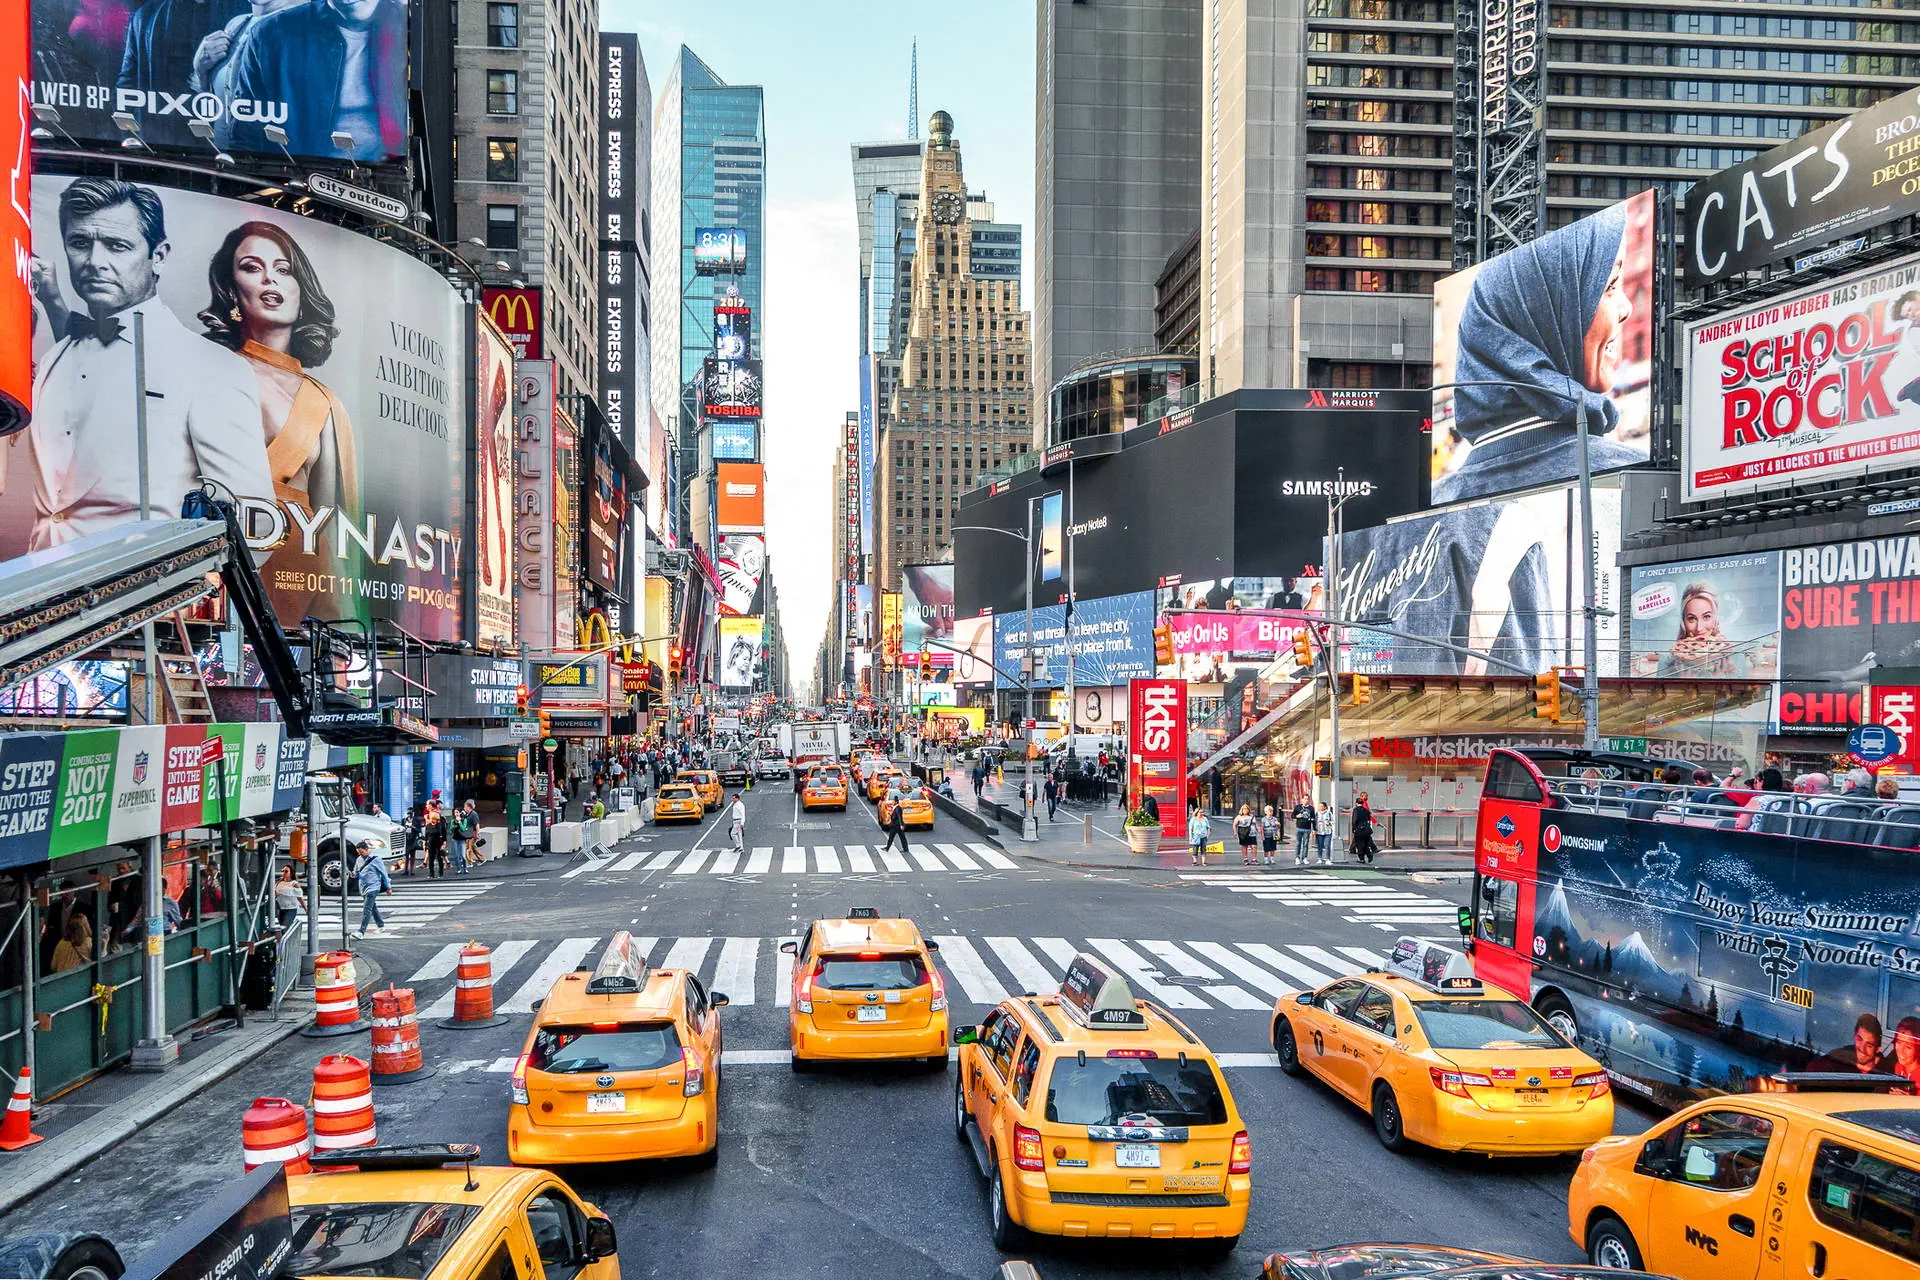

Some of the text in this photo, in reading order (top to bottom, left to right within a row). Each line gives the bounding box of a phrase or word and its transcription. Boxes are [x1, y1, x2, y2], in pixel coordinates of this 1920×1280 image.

[608, 46, 622, 119] EXPRESS
[40, 81, 81, 107] WED
[86, 85, 110, 111] 8P
[608, 131, 621, 198] EXPRESS
[318, 180, 401, 213] city outdoor
[1696, 120, 1853, 271] CATS
[1792, 207, 1870, 239] CATSBROADWAY.COM
[702, 232, 738, 248] 8:30
[720, 298, 744, 307] 2017
[1744, 308, 1780, 332] LLOYD
[1782, 293, 1830, 320] WEBBER
[1832, 285, 1857, 307] HAS
[390, 320, 446, 371] VICIOUS.
[607, 297, 621, 373] EXPRESS
[1721, 300, 1904, 387] SCHOOL
[1786, 356, 1823, 397] of
[1332, 391, 1380, 399] MARRIOTT
[1332, 399, 1375, 407] MARQUIS
[1720, 351, 1901, 450] ROCK
[705, 405, 761, 416] TOSHIBA
[1171, 407, 1196, 421] MARRIOTT
[863, 404, 871, 446] NINJAS
[1170, 416, 1193, 430] MARQUIS
[1789, 432, 1821, 447] MUSICAL
[864, 451, 872, 478] PLAY
[1743, 462, 1765, 477] JUST
[1767, 461, 1774, 475] 4
[1775, 454, 1811, 471] BLOCKS
[1813, 452, 1826, 464] TO
[1828, 448, 1846, 461] THE
[1848, 440, 1888, 457] WINTER
[520, 376, 541, 591] PALACE
[1282, 480, 1371, 496] SAMSUNG
[1087, 516, 1107, 530] Note8
[236, 495, 462, 581] DYNASTY
[275, 570, 305, 583] SERIES
[1336, 521, 1451, 623] Honestly
[1639, 556, 1768, 578] IF ONLY LIFE WERE AS EASY AS PIE
[275, 582, 305, 593] PREMIERE
[307, 572, 337, 594] OCT
[339, 576, 354, 596] 11
[358, 578, 388, 600] WED
[391, 582, 405, 601] 9P
[907, 605, 938, 618] KNOW
[1784, 584, 1860, 630] SURE
[1005, 618, 1129, 643] Next you leave the city,
[1194, 622, 1229, 642] On Us
[1083, 641, 1104, 655] places
[1105, 638, 1124, 650] from
[1125, 636, 1133, 649] it.
[1356, 653, 1373, 661] THE
[471, 669, 489, 685] STAY
[489, 671, 496, 685] IN
[476, 688, 492, 704] NEW
[309, 712, 381, 723] NORTH SHORE
[555, 720, 592, 728] NOVEMBER
[1144, 685, 1178, 752] tkts
[280, 740, 306, 760] STEP
[801, 741, 831, 749] MIVILA
[1370, 736, 1414, 759] tkts
[1413, 737, 1456, 759] tkts
[1611, 739, 1635, 751] W 47
[69, 753, 112, 767] COMING SOON
[168, 746, 201, 769] STEP
[279, 759, 305, 773] INTO THE
[1851, 753, 1895, 768] NO STANDING
[2, 760, 56, 791] STEP
[65, 764, 111, 797] NOV
[167, 769, 201, 785] INTO THE
[245, 774, 272, 790] EXPERIENCE
[278, 772, 304, 790] GAME
[1602, 768, 1617, 777] WAY
[166, 784, 201, 807] GAME
[207, 775, 239, 800] 217
[1354, 781, 1359, 790] 1
[1388, 781, 1395, 790] 2
[1423, 781, 1430, 790] 3
[1457, 781, 1464, 790] 4
[0, 790, 52, 811] INTO THE
[117, 788, 157, 809] EXPERIENCE
[60, 792, 107, 827] 2017
[0, 807, 49, 838] GAME
[1561, 835, 1605, 852] NONGSHIM
[1694, 882, 1909, 933] Enjoy Your Summer
[1715, 930, 1759, 955] with
[1800, 939, 1883, 968] Noodle
[1781, 984, 1813, 1008] SHIN
[1103, 1010, 1131, 1022] 4M97
[1685, 1224, 1719, 1257] NYC
[214, 1233, 254, 1280] seem so
